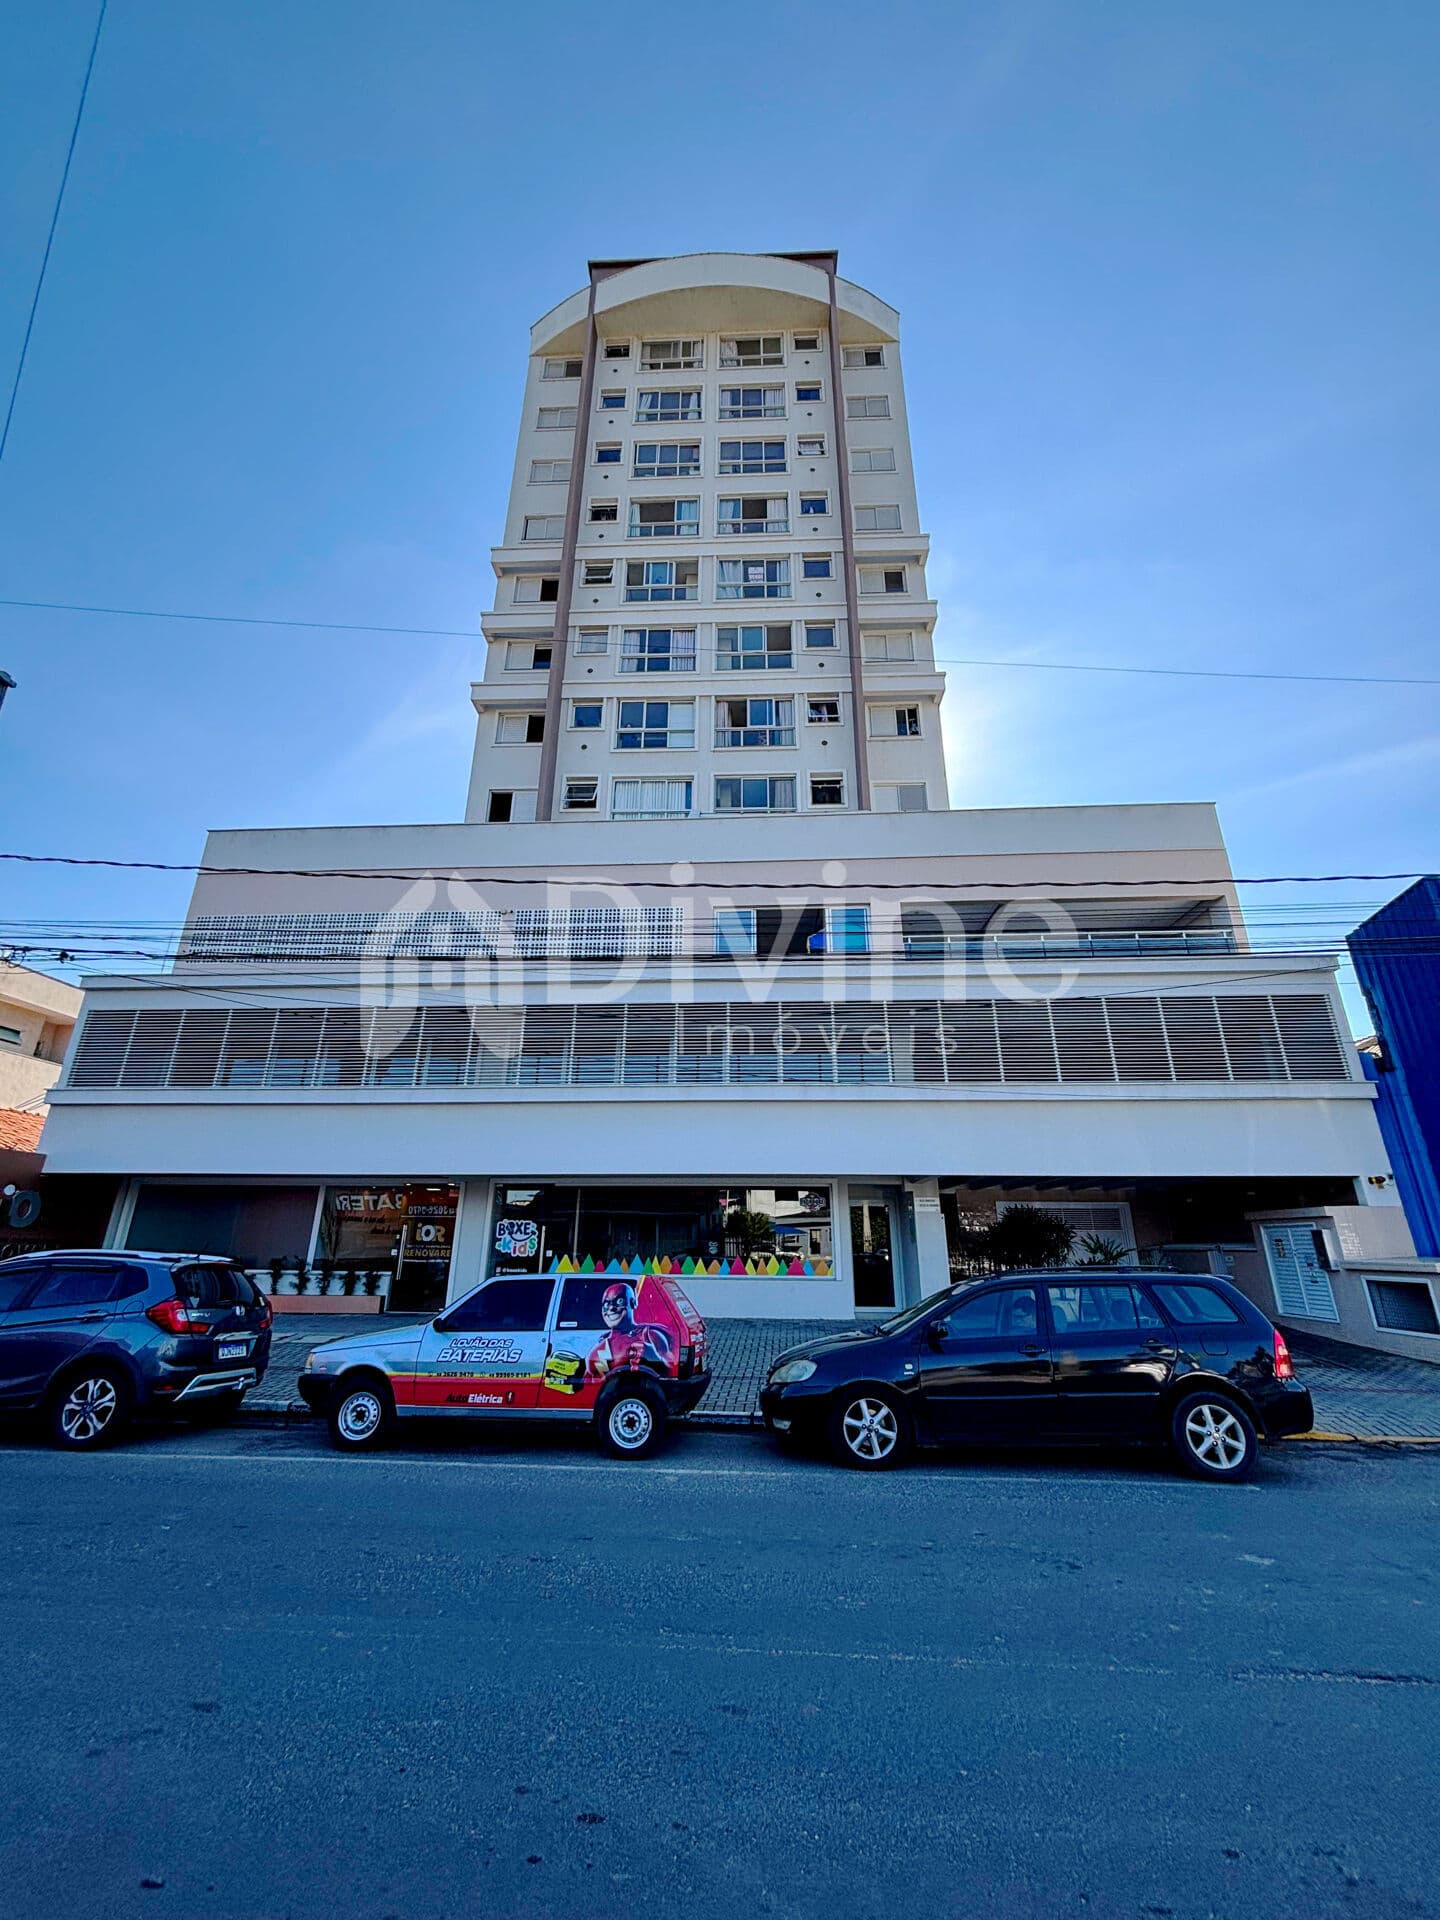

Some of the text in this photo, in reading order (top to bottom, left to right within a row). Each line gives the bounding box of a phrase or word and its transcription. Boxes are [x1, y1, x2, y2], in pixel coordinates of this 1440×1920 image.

[497, 1221, 532, 1236] BOXE
[450, 1336, 513, 1348] LOJÃO DAS
[437, 1348, 523, 1363] BATERIAS
